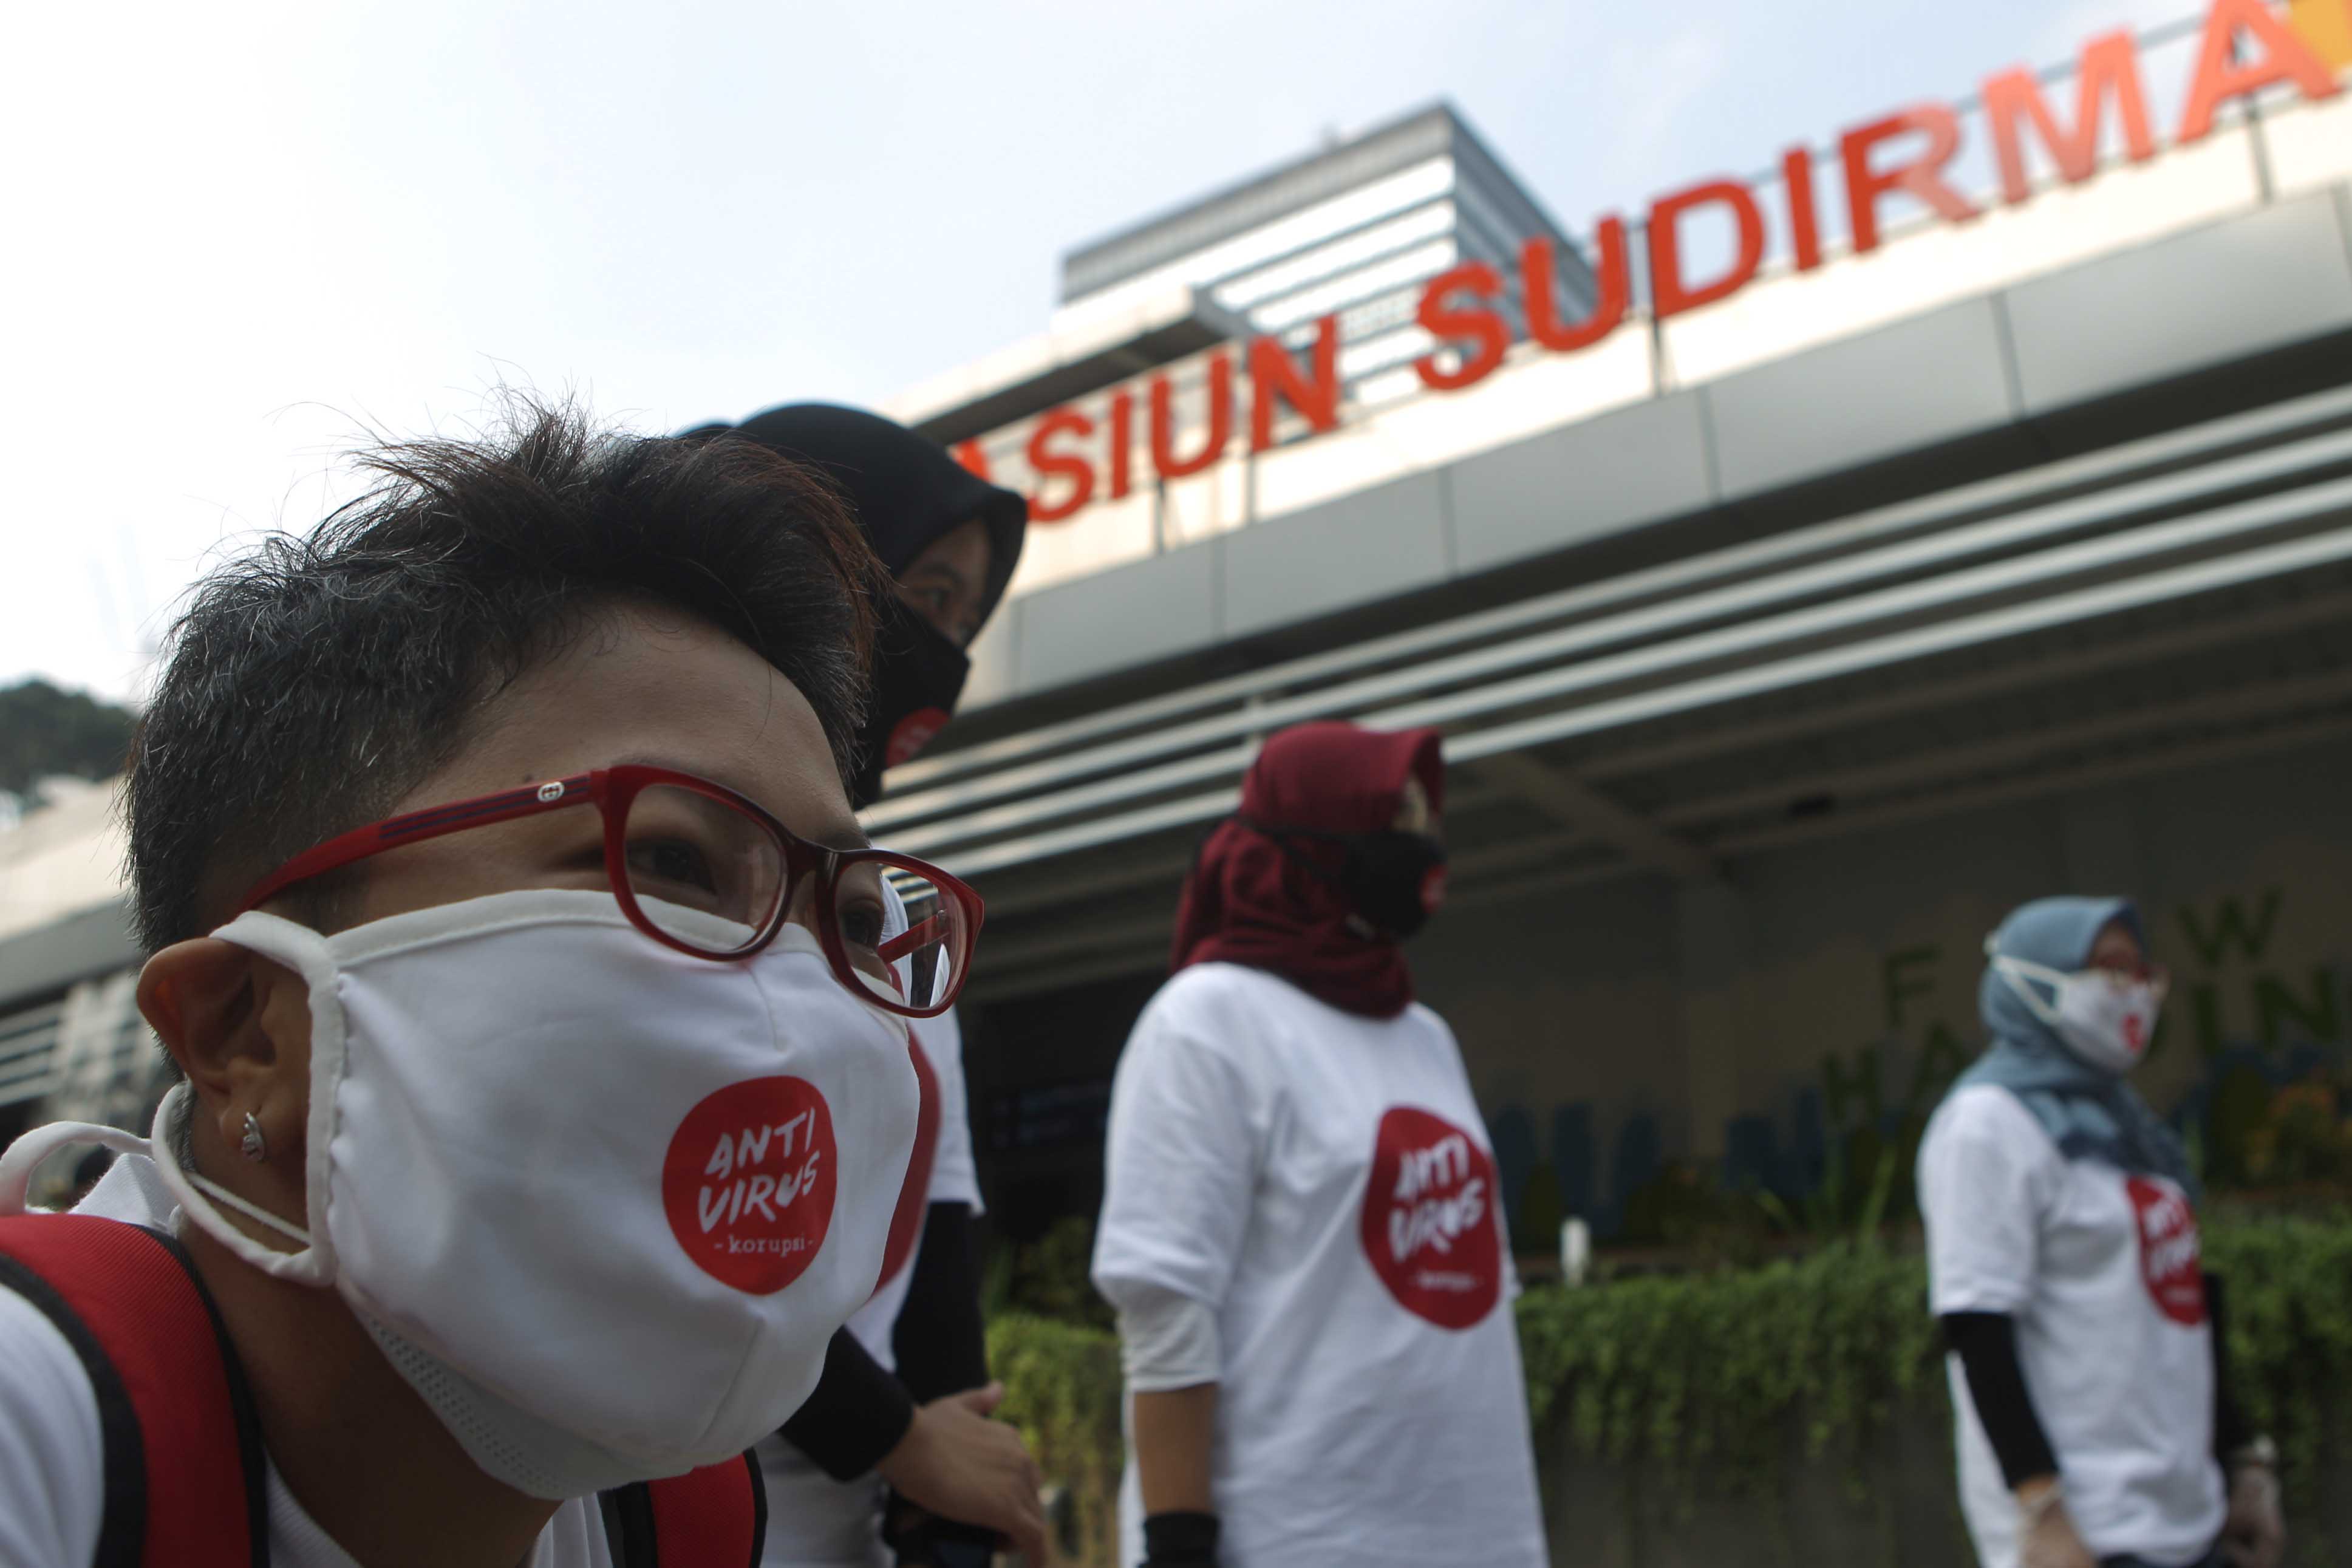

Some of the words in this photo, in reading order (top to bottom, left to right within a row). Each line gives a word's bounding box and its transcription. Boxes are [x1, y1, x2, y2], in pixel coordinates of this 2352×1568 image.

[955, 315, 1340, 522] SIUN
[705, 1107, 815, 1180] ANTI
[699, 1150, 820, 1233] VIRUS
